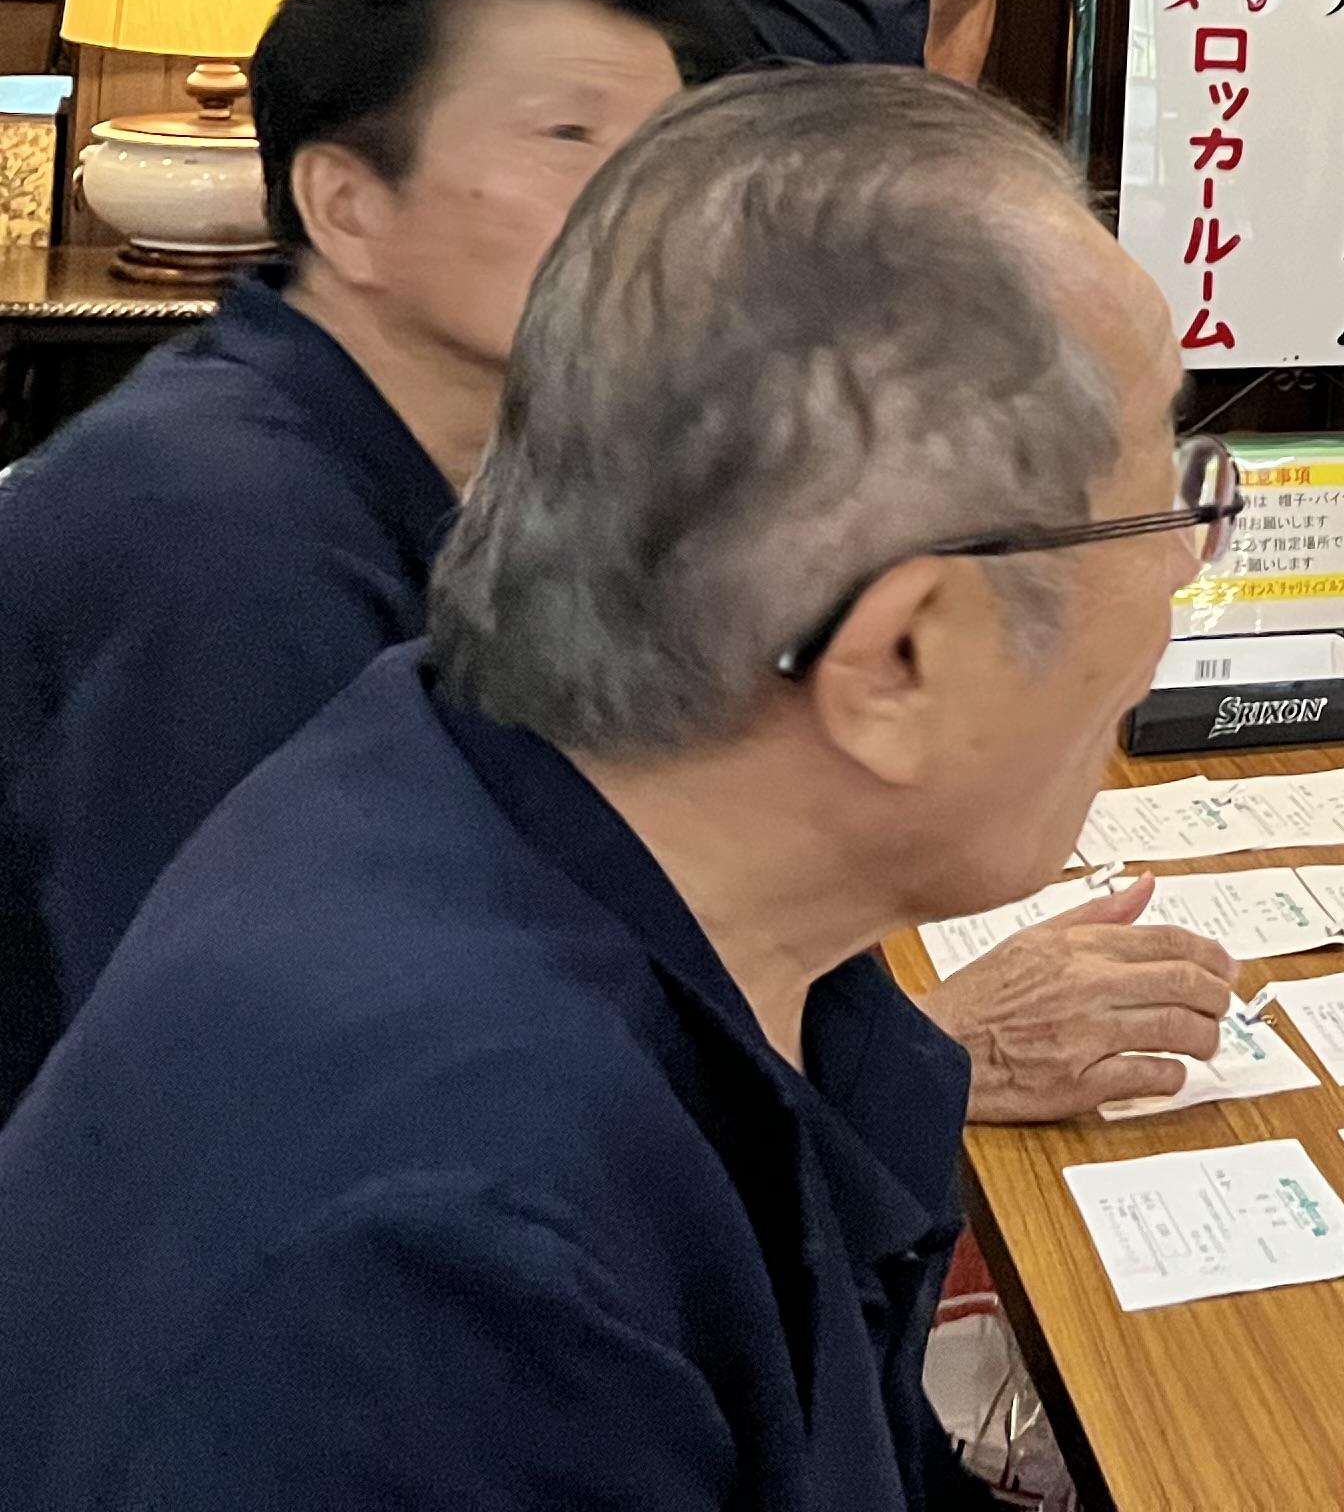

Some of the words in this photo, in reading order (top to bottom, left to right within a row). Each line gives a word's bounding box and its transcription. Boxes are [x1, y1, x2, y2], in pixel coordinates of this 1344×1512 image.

[1181, 28, 1249, 349] ロッカールーム
[1208, 696, 1328, 739] SRIXON
